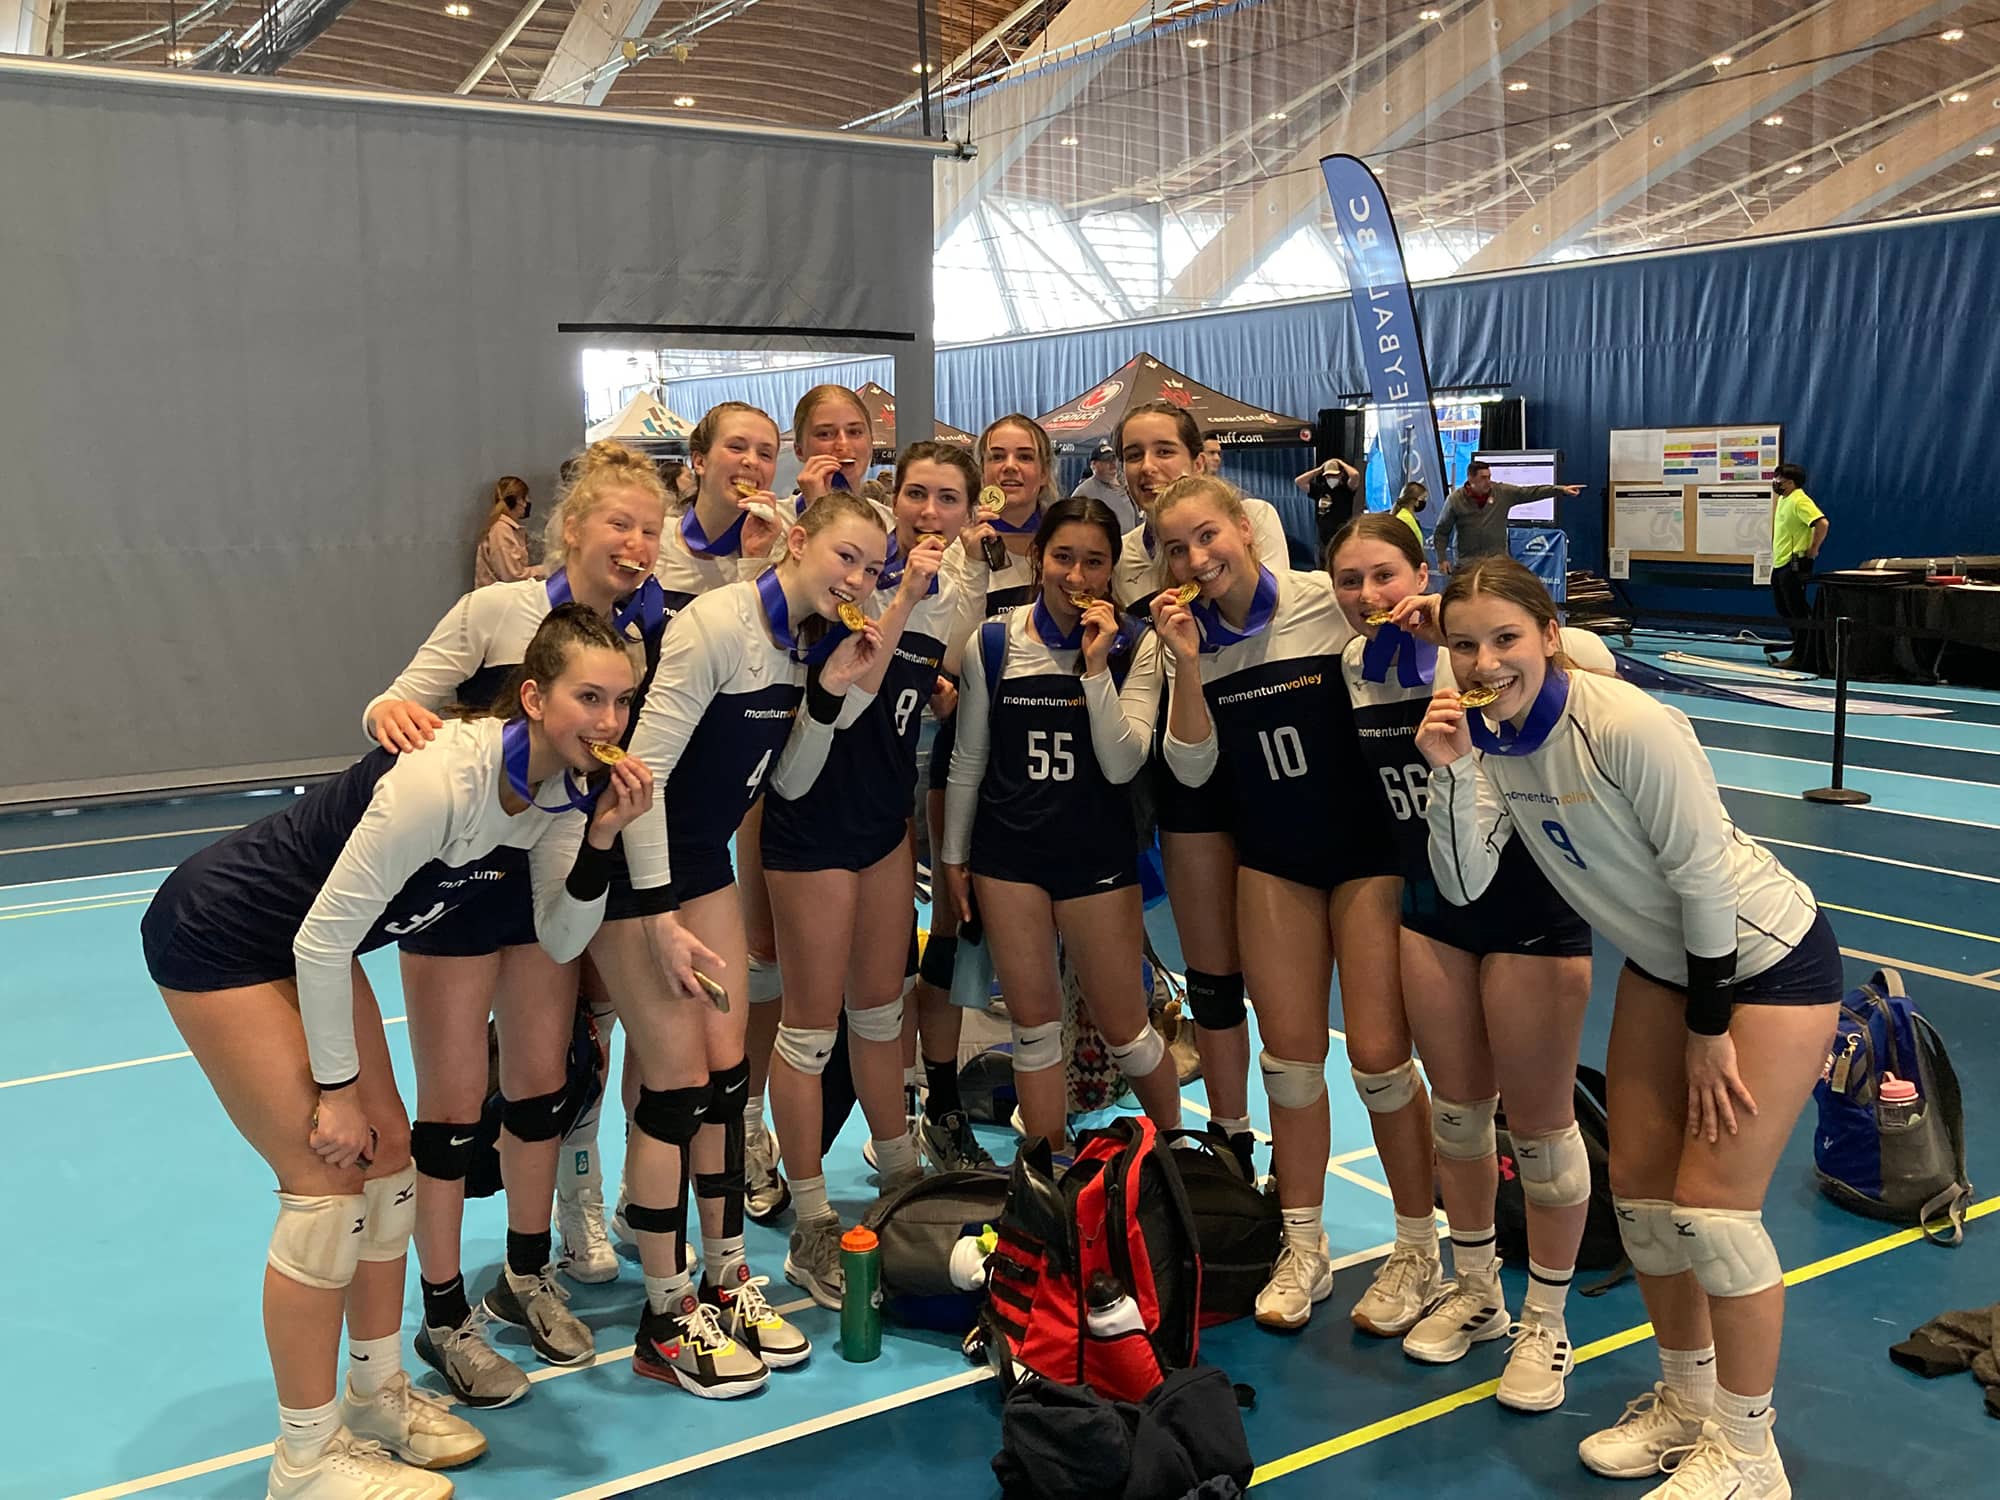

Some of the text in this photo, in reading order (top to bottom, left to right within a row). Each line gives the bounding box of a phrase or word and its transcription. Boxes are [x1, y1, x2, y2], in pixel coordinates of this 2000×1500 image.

[895, 688, 918, 736] 8
[1003, 694, 1087, 708] momentumvoll
[1218, 673, 1322, 705] momentumvolley
[746, 749, 772, 799] 4
[1027, 730, 1075, 781] 55
[1258, 726, 1308, 781] 10
[1379, 763, 1428, 820] 66
[1541, 820, 1587, 870] 9
